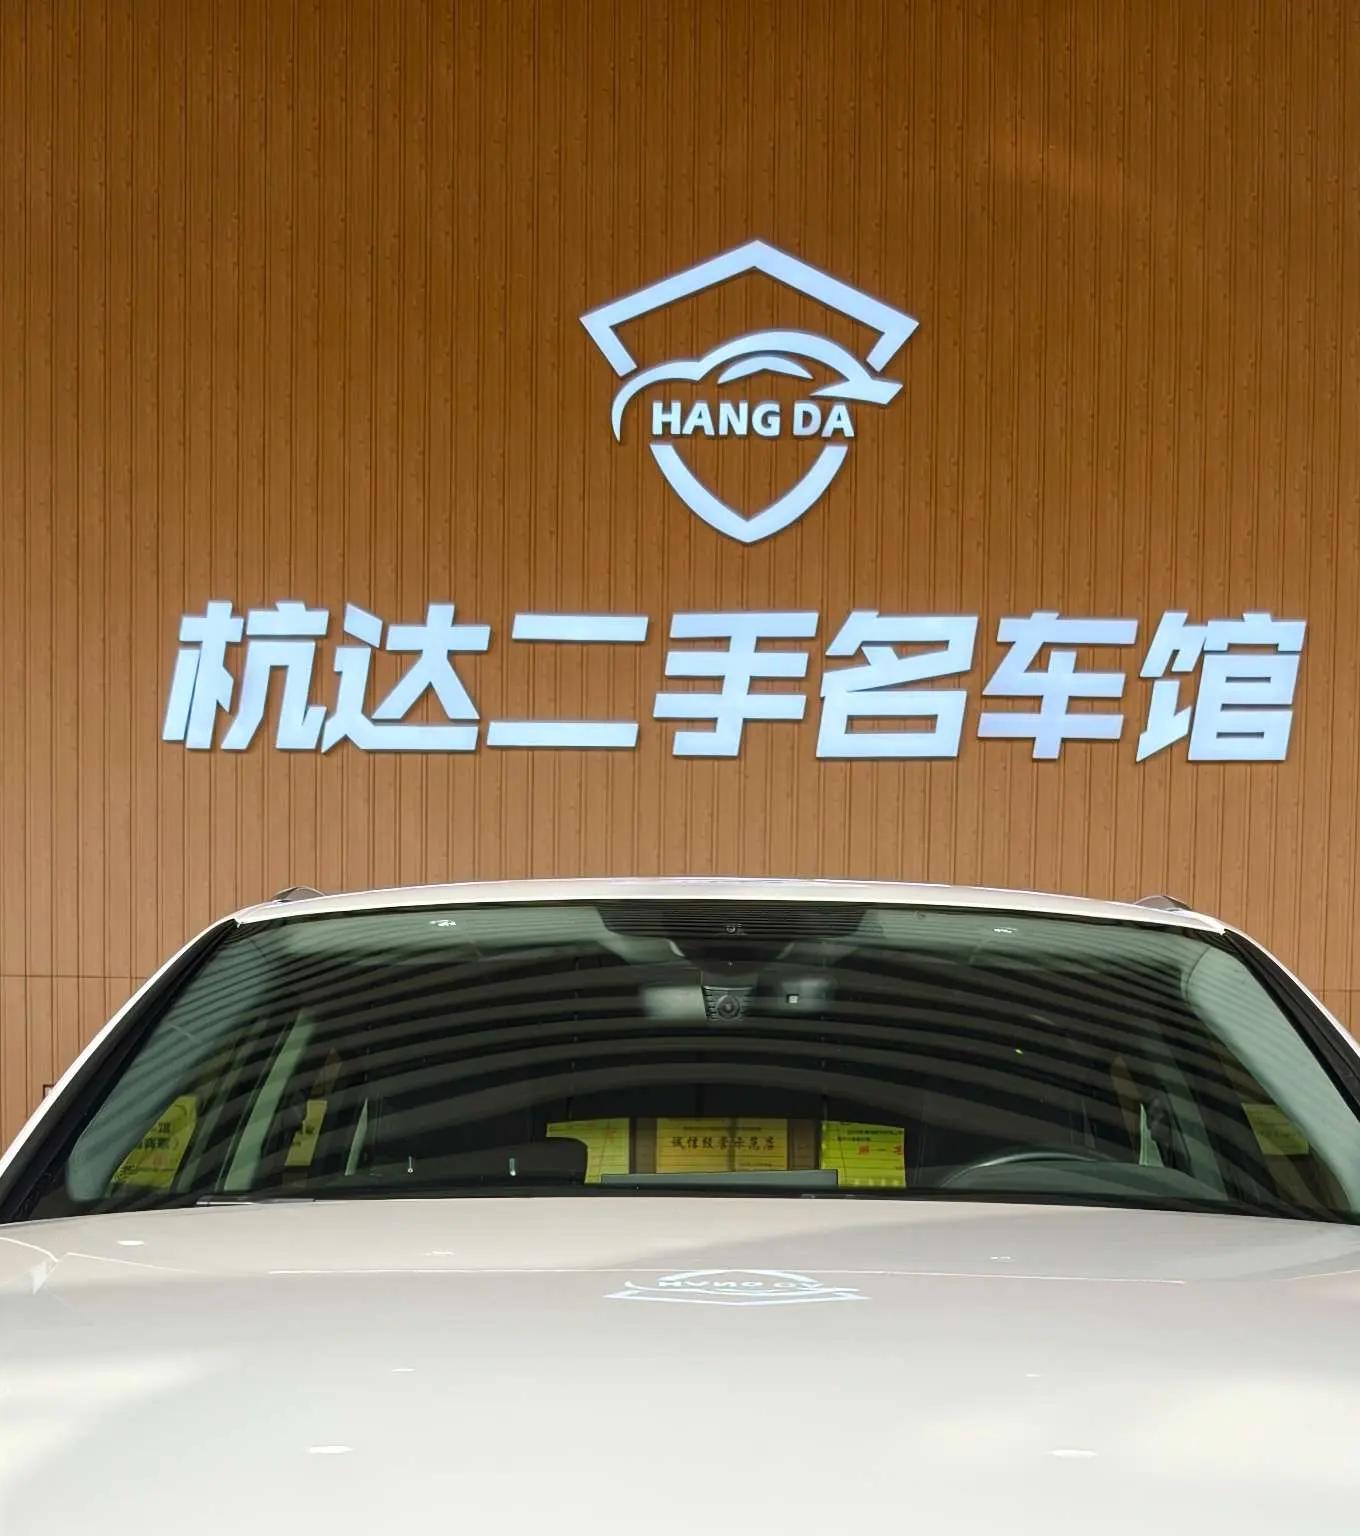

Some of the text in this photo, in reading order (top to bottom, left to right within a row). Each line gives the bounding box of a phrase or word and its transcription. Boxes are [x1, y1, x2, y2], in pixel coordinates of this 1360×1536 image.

[652, 401, 855, 438] HANG DA
[162, 600, 1307, 763] 杭达二手名车馆
